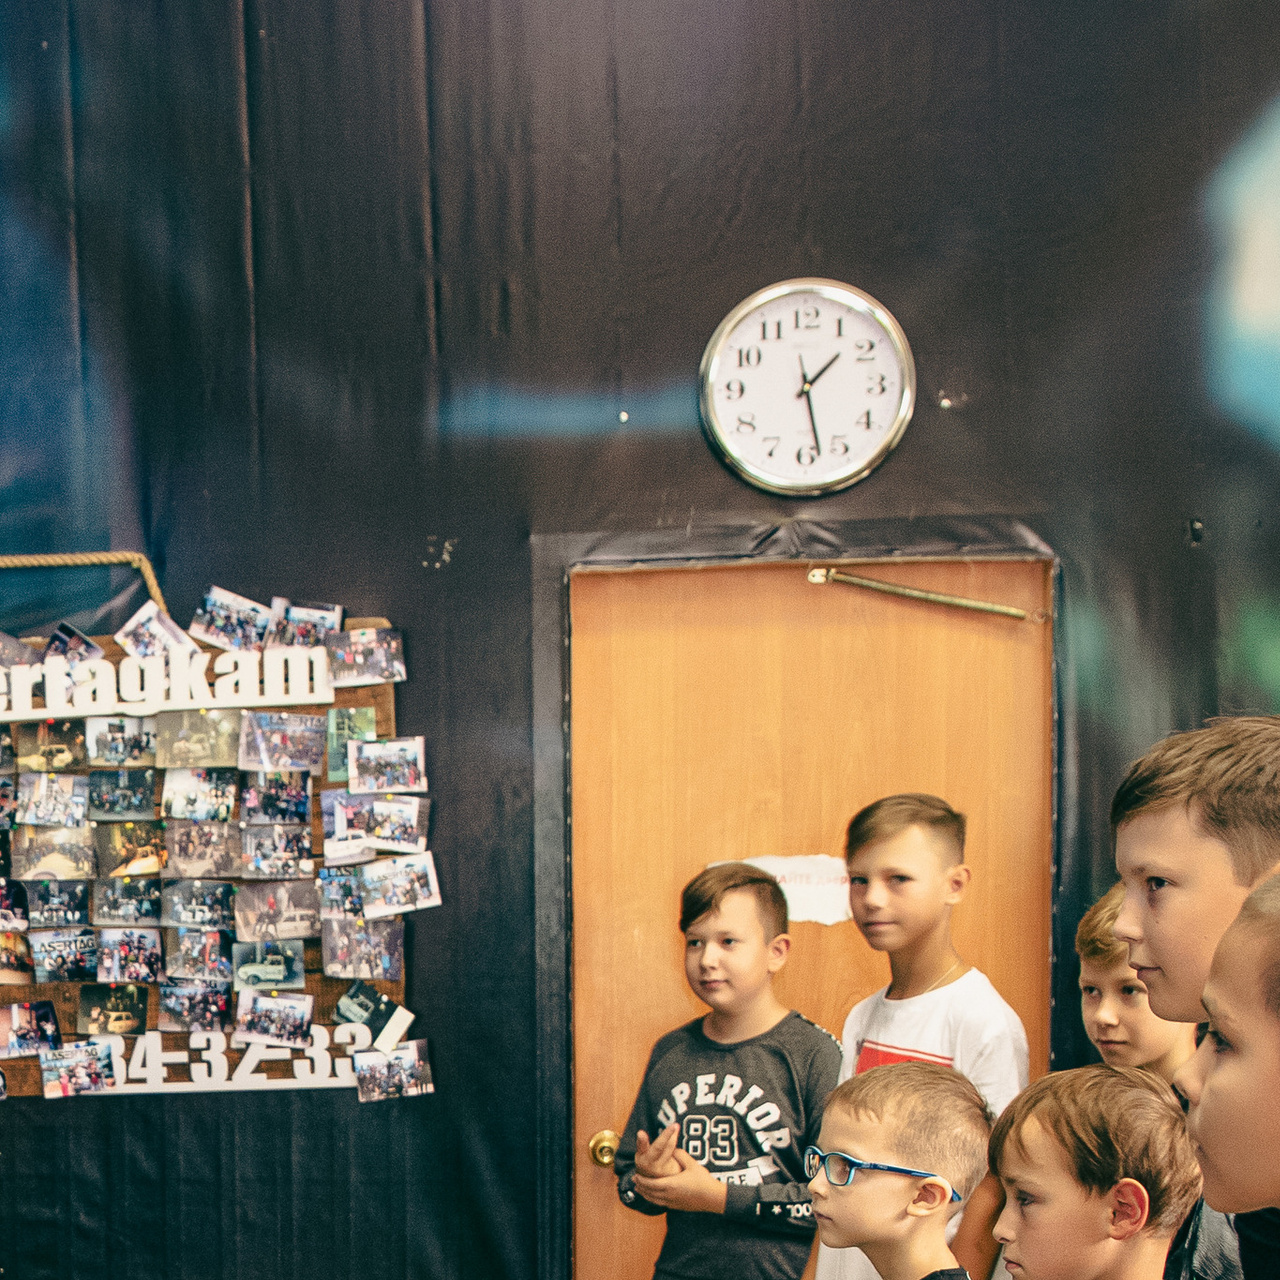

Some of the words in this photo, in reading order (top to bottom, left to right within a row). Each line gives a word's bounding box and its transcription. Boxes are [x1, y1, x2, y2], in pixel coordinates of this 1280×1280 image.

[793, 306, 820, 329] 12
[836, 318, 844, 338] 1
[761, 320, 782, 340] 11
[737, 346, 761, 367] 10
[856, 339, 875, 362] 2
[726, 379, 745, 400] 9
[867, 374, 886, 395] 3
[736, 412, 756, 433] 8
[856, 409, 873, 430] 4
[763, 437, 780, 457] 7
[797, 444, 816, 465] 6
[830, 435, 849, 456] 5
[657, 1074, 791, 1153] UPERIOR
[682, 1115, 740, 1167] 83
